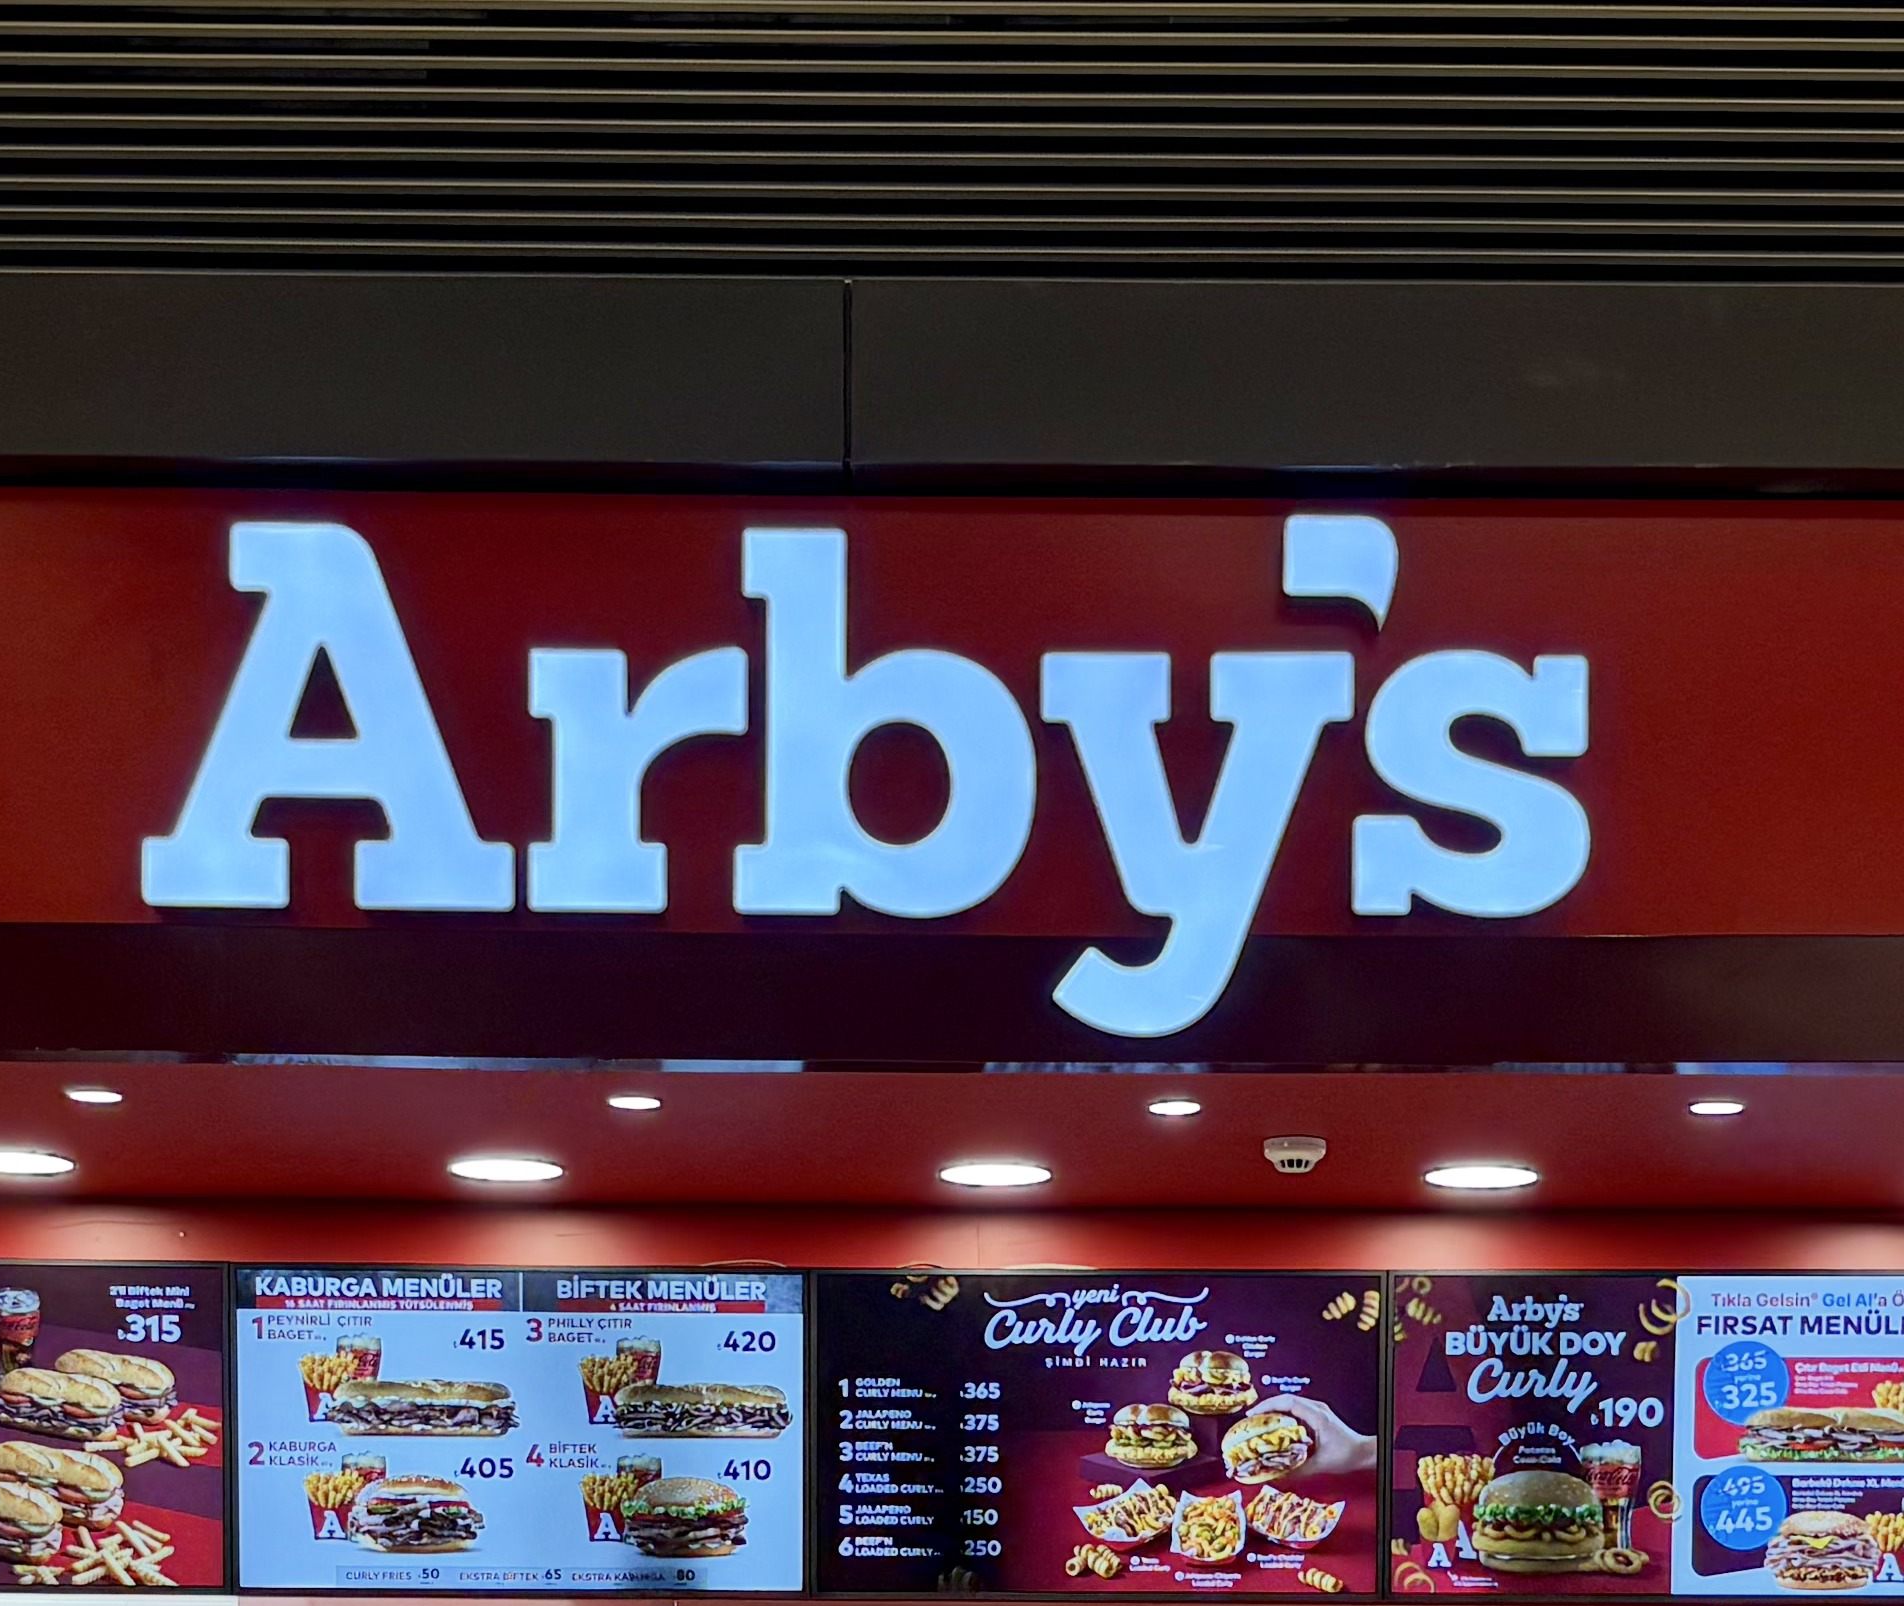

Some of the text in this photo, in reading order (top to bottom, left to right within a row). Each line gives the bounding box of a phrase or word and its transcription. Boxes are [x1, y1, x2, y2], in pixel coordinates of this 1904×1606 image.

[141, 514, 1591, 1038] Arby's
[129, 1286, 163, 1296] Biftek
[256, 1273, 502, 1298] KABURGA MENÜLER
[557, 1275, 767, 1300] BİFTEK MENÜLER
[1073, 1284, 1119, 1310] yeni
[1711, 1293, 1751, 1307] Tıkla
[1823, 1293, 1851, 1307] Gel
[299, 1300, 325, 1309] SAAT
[619, 1303, 645, 1312] SAAT
[1487, 1295, 1581, 1328] Arby's
[268, 1313, 372, 1327] PEYNİRLİ ÇITIR
[548, 1319, 632, 1331] PHILLY ÇITIR
[1697, 1316, 1793, 1334] FIRSAT
[268, 1330, 313, 1340] BAGET
[984, 1308, 1102, 1356] Curly
[1109, 1306, 1207, 1347] Club
[548, 1333, 593, 1342] BAGET
[1446, 1325, 1626, 1356] BÜYÜK DOY
[1045, 1357, 1146, 1368] ŞİMDİ HAZIR
[1467, 1358, 1598, 1414] Curly
[856, 1389, 889, 1397] CURLY
[1722, 1382, 1777, 1409] 325
[856, 1421, 889, 1429] CURLY
[269, 1442, 336, 1452] KABURGA
[549, 1441, 596, 1453] BİFTEK
[269, 1453, 318, 1466] KLASİK
[549, 1455, 599, 1468] KLASİK
[856, 1453, 889, 1461] CURLY
[856, 1474, 889, 1482] TEXAS
[856, 1485, 934, 1493] LOADED CURLY
[856, 1516, 934, 1525] LOADED CURLY
[1716, 1507, 1772, 1533] 445
[856, 1548, 933, 1556] LOADED CURLY
[346, 1572, 412, 1580] CURLY FRIES
[460, 1572, 499, 1581] EKSTRA
